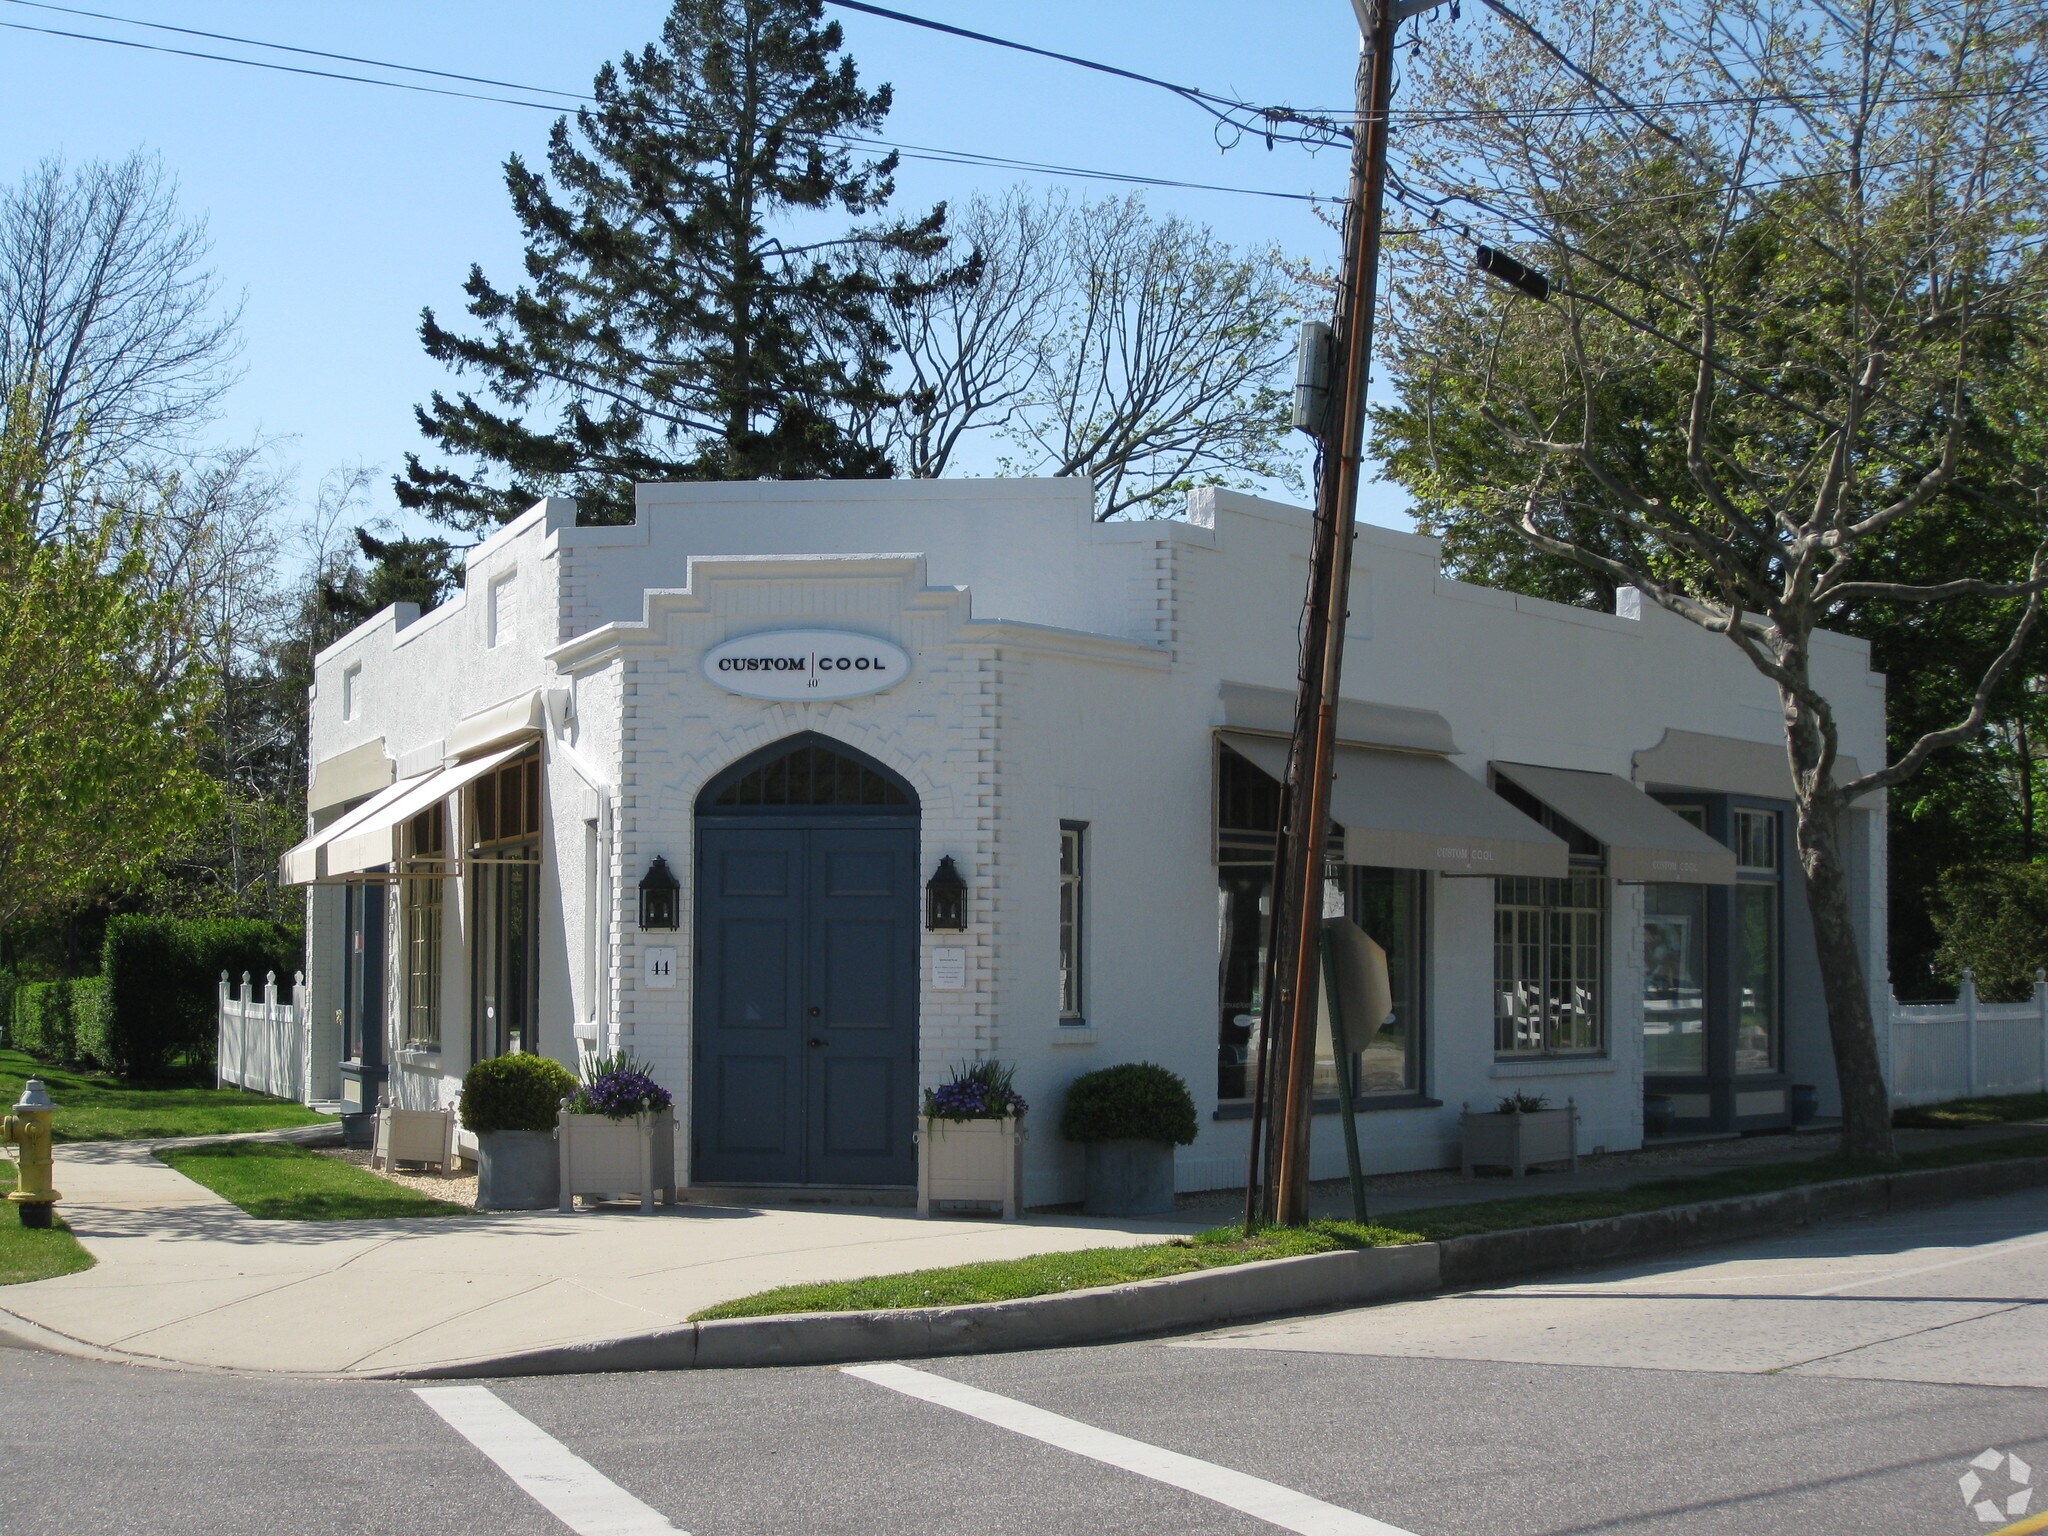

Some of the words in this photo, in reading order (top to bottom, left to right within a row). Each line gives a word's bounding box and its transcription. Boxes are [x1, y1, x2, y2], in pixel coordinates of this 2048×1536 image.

[718, 657, 806, 671] CUSTOM
[818, 657, 886, 671] COOL
[1435, 847, 1468, 859] CUSTOM
[1471, 849, 1495, 861] COOL
[651, 960, 670, 975] 44
